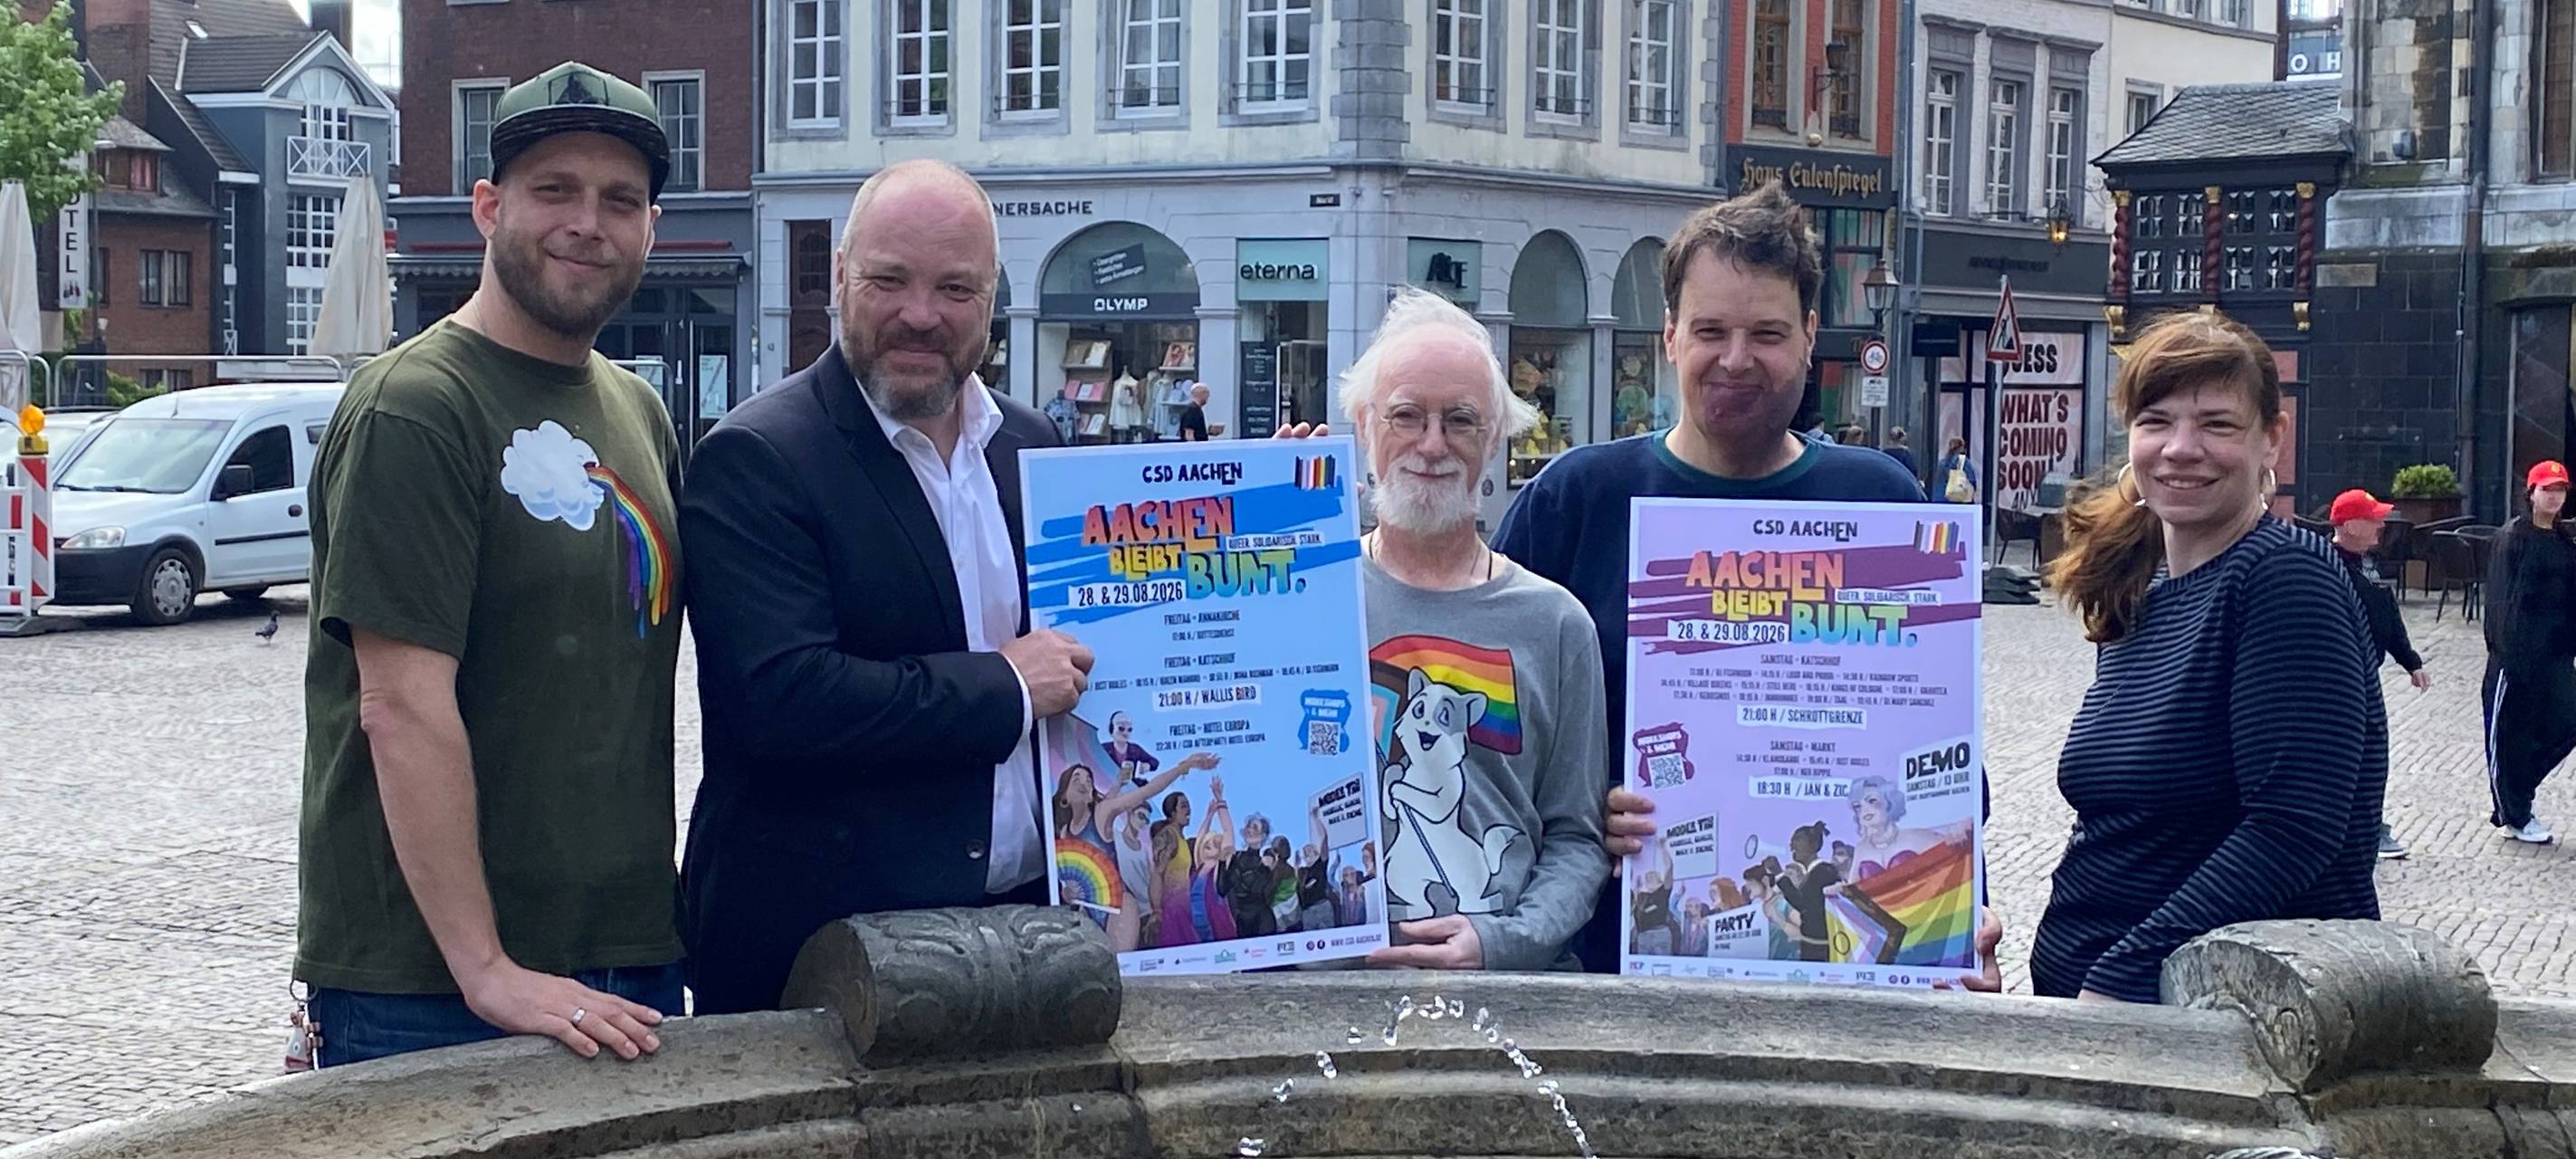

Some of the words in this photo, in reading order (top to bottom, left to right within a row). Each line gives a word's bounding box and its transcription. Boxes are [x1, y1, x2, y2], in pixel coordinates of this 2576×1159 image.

[1240, 260, 1317, 280] eterna
[1094, 297, 1148, 311] OLYMP
[1142, 465, 1174, 483] CSD
[1178, 462, 1243, 485] AACHEN
[1082, 495, 1236, 552] AACHEN
[1753, 520, 1785, 536] CSD
[1789, 520, 1857, 541] AACHEN
[1109, 542, 1186, 580] BLEIBT
[1186, 549, 1307, 599] BUNT.
[1686, 550, 1845, 601] AACHEN
[1078, 589, 1098, 607] 28.
[1102, 587, 1111, 604] &
[1113, 581, 1183, 605] 29.08.2026
[1712, 589, 1789, 620] BLEIBT
[1677, 623, 1697, 640] 28.
[1702, 623, 1710, 639] &
[1713, 623, 1785, 642] 29.08.2026
[1791, 599, 1917, 647] BUNT.
[1159, 692, 1183, 707] 21:00
[1201, 686, 1234, 704] WALLIS
[1236, 685, 1257, 701] BIRD
[1742, 707, 1768, 722] 21:00
[1770, 708, 1777, 722] H
[1770, 740, 1803, 752] SAMSTAG
[1811, 742, 1836, 753] MARKT
[1906, 742, 1970, 780] DEMO
[1758, 781, 1781, 795] 18:30
[1804, 782, 1821, 797] JAN
[1824, 783, 1830, 797] &
[1715, 911, 1756, 934] PARTY
